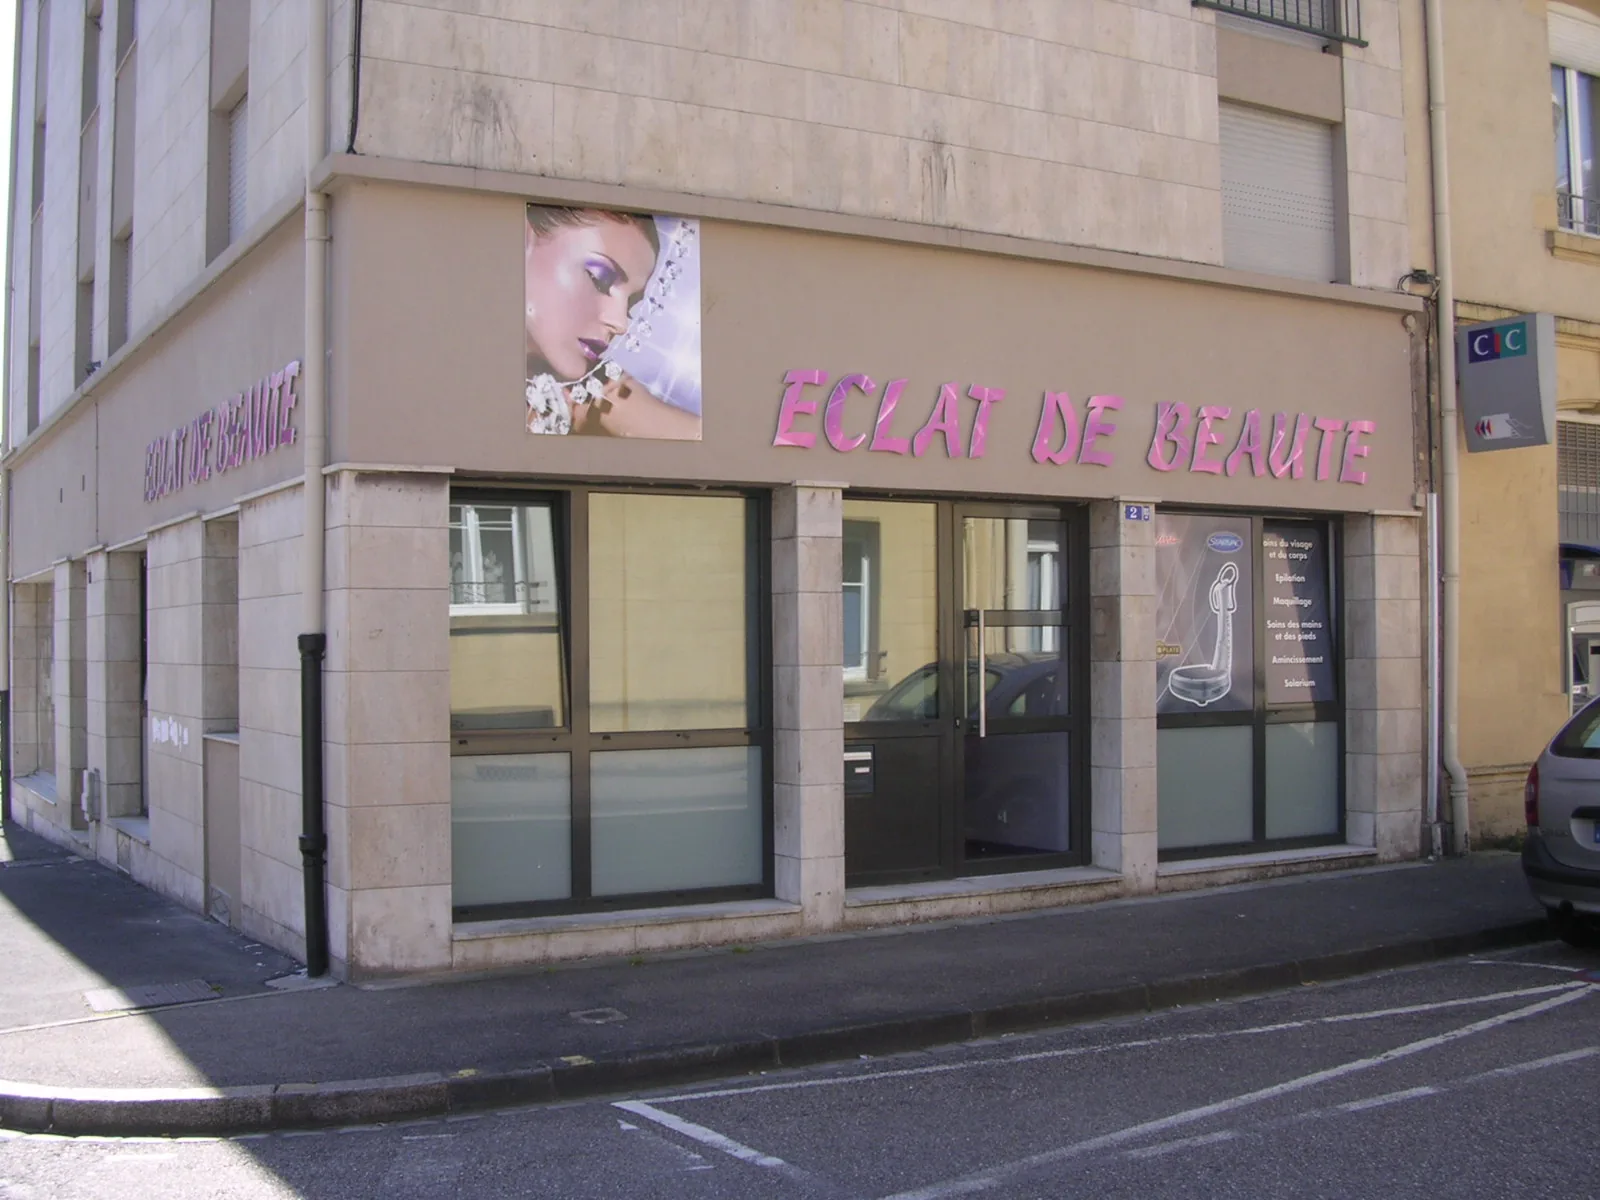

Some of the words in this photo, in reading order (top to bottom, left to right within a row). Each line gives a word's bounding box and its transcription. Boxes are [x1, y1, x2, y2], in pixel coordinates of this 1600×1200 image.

[1473, 329, 1521, 356] CIC
[144, 425, 188, 502] ECLAT
[189, 409, 213, 485] DE
[216, 360, 301, 473] BEAUTE
[772, 368, 1006, 460] ECLAT
[1031, 389, 1124, 466] DE
[1146, 399, 1377, 485] BEAUTE
[1263, 538, 1278, 547] oins
[1279, 538, 1289, 547] du
[1290, 539, 1313, 551] visage
[1269, 551, 1276, 559] et
[1277, 550, 1287, 559] du
[1288, 552, 1308, 561] corps
[1275, 573, 1306, 584] Epilation
[1273, 596, 1312, 607] Maquillage
[1266, 619, 1286, 629] Soins
[1287, 619, 1300, 629] des
[1301, 619, 1322, 629] mains
[1283, 631, 1296, 640] des
[1297, 631, 1317, 642] pieds
[1271, 655, 1324, 664] Amincissement
[1284, 678, 1316, 688] Solarium
